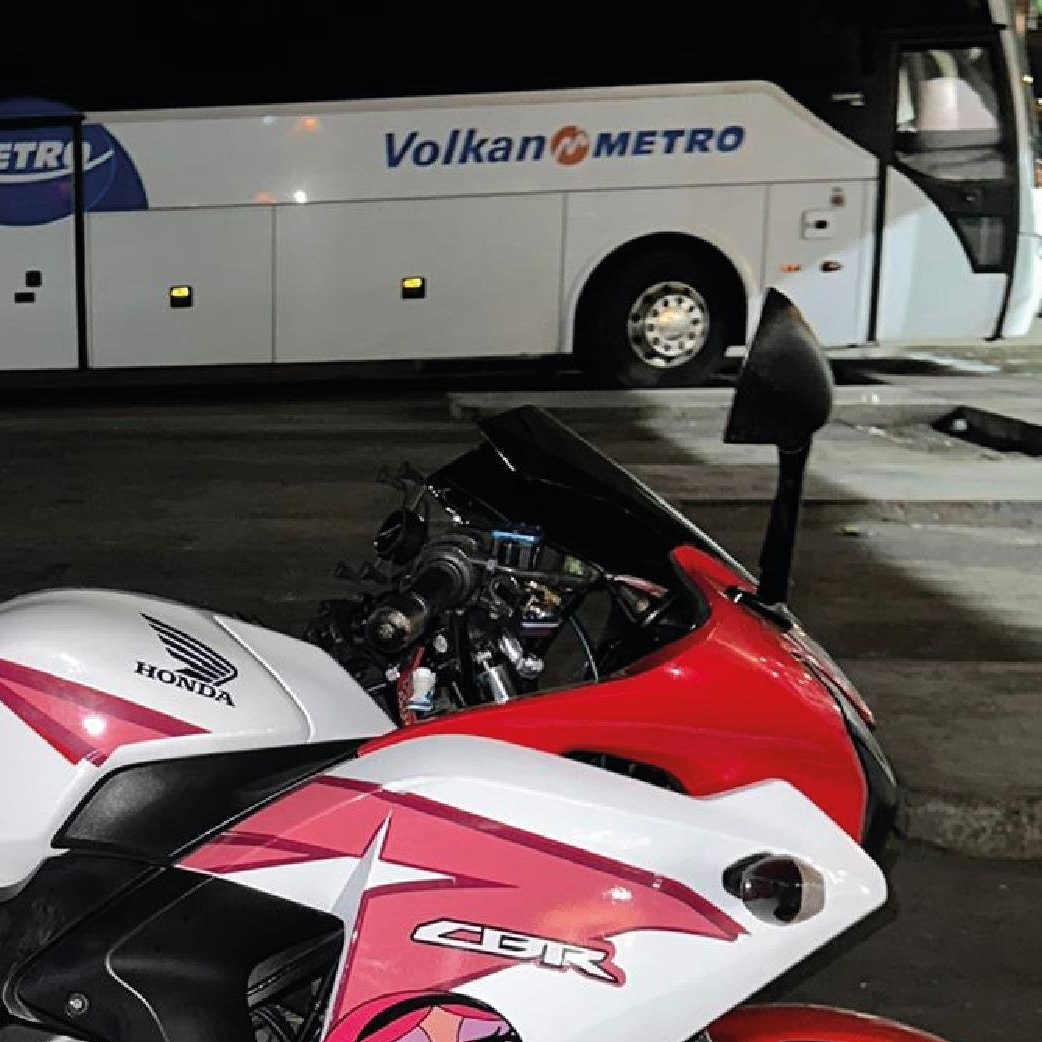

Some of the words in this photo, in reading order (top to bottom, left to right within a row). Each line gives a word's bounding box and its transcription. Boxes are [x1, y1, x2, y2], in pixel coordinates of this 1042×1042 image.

[385, 128, 545, 168] Volkan
[592, 125, 745, 158] METRO
[135, 661, 235, 707] HONDA
[411, 918, 619, 983] CBR
